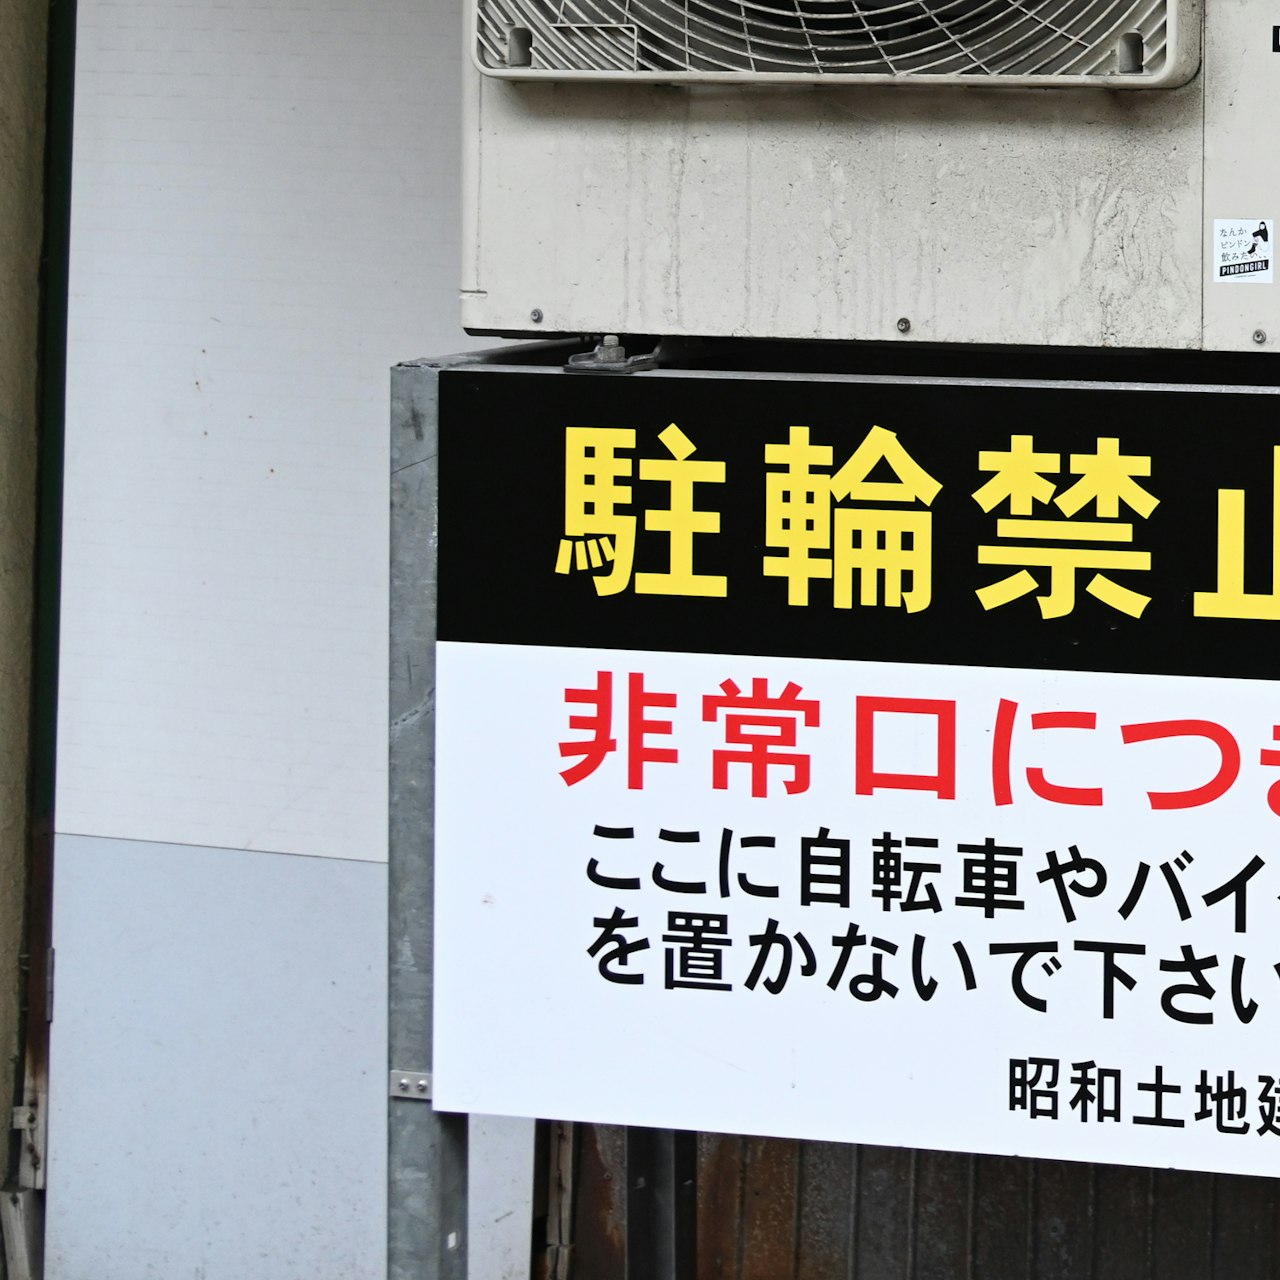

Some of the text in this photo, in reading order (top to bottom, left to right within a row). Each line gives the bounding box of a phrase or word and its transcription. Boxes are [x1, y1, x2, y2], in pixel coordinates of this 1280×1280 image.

[1219, 227, 1247, 237] なんか
[1221, 261, 1267, 275] PINDONGIRL
